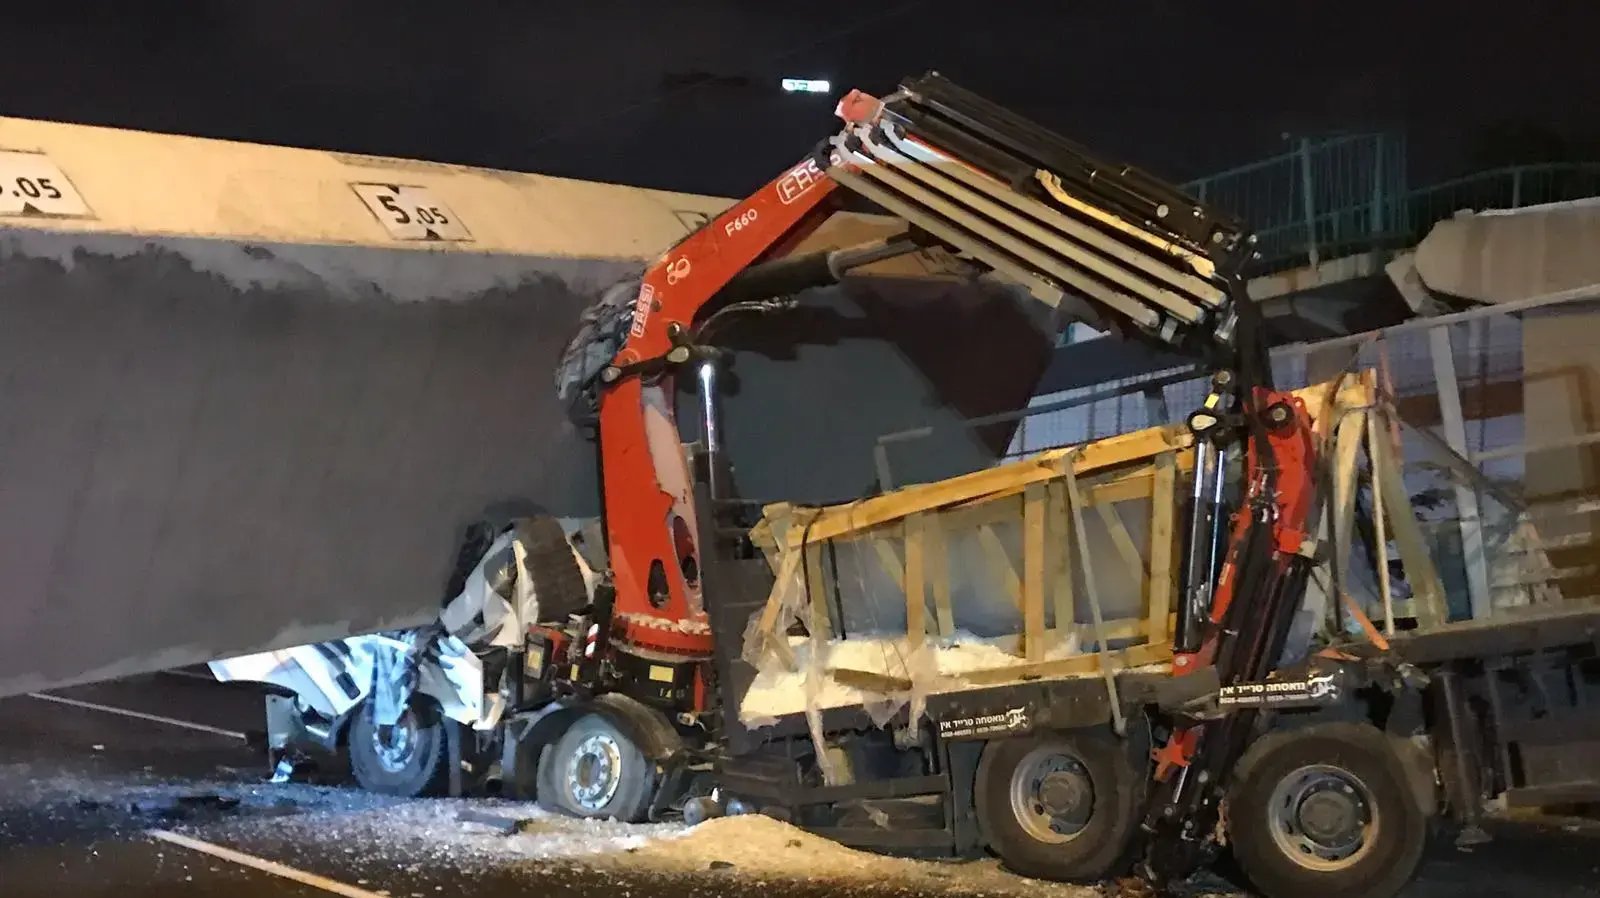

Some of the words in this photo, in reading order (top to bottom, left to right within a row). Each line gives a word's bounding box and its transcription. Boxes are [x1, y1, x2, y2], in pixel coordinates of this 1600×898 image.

[0, 176, 62, 199] .05
[376, 195, 449, 225] 5.05
[724, 208, 758, 237] F660
[633, 285, 653, 334] FASSI
[1220, 686, 1235, 697] אין
[940, 721, 952, 731] אין
